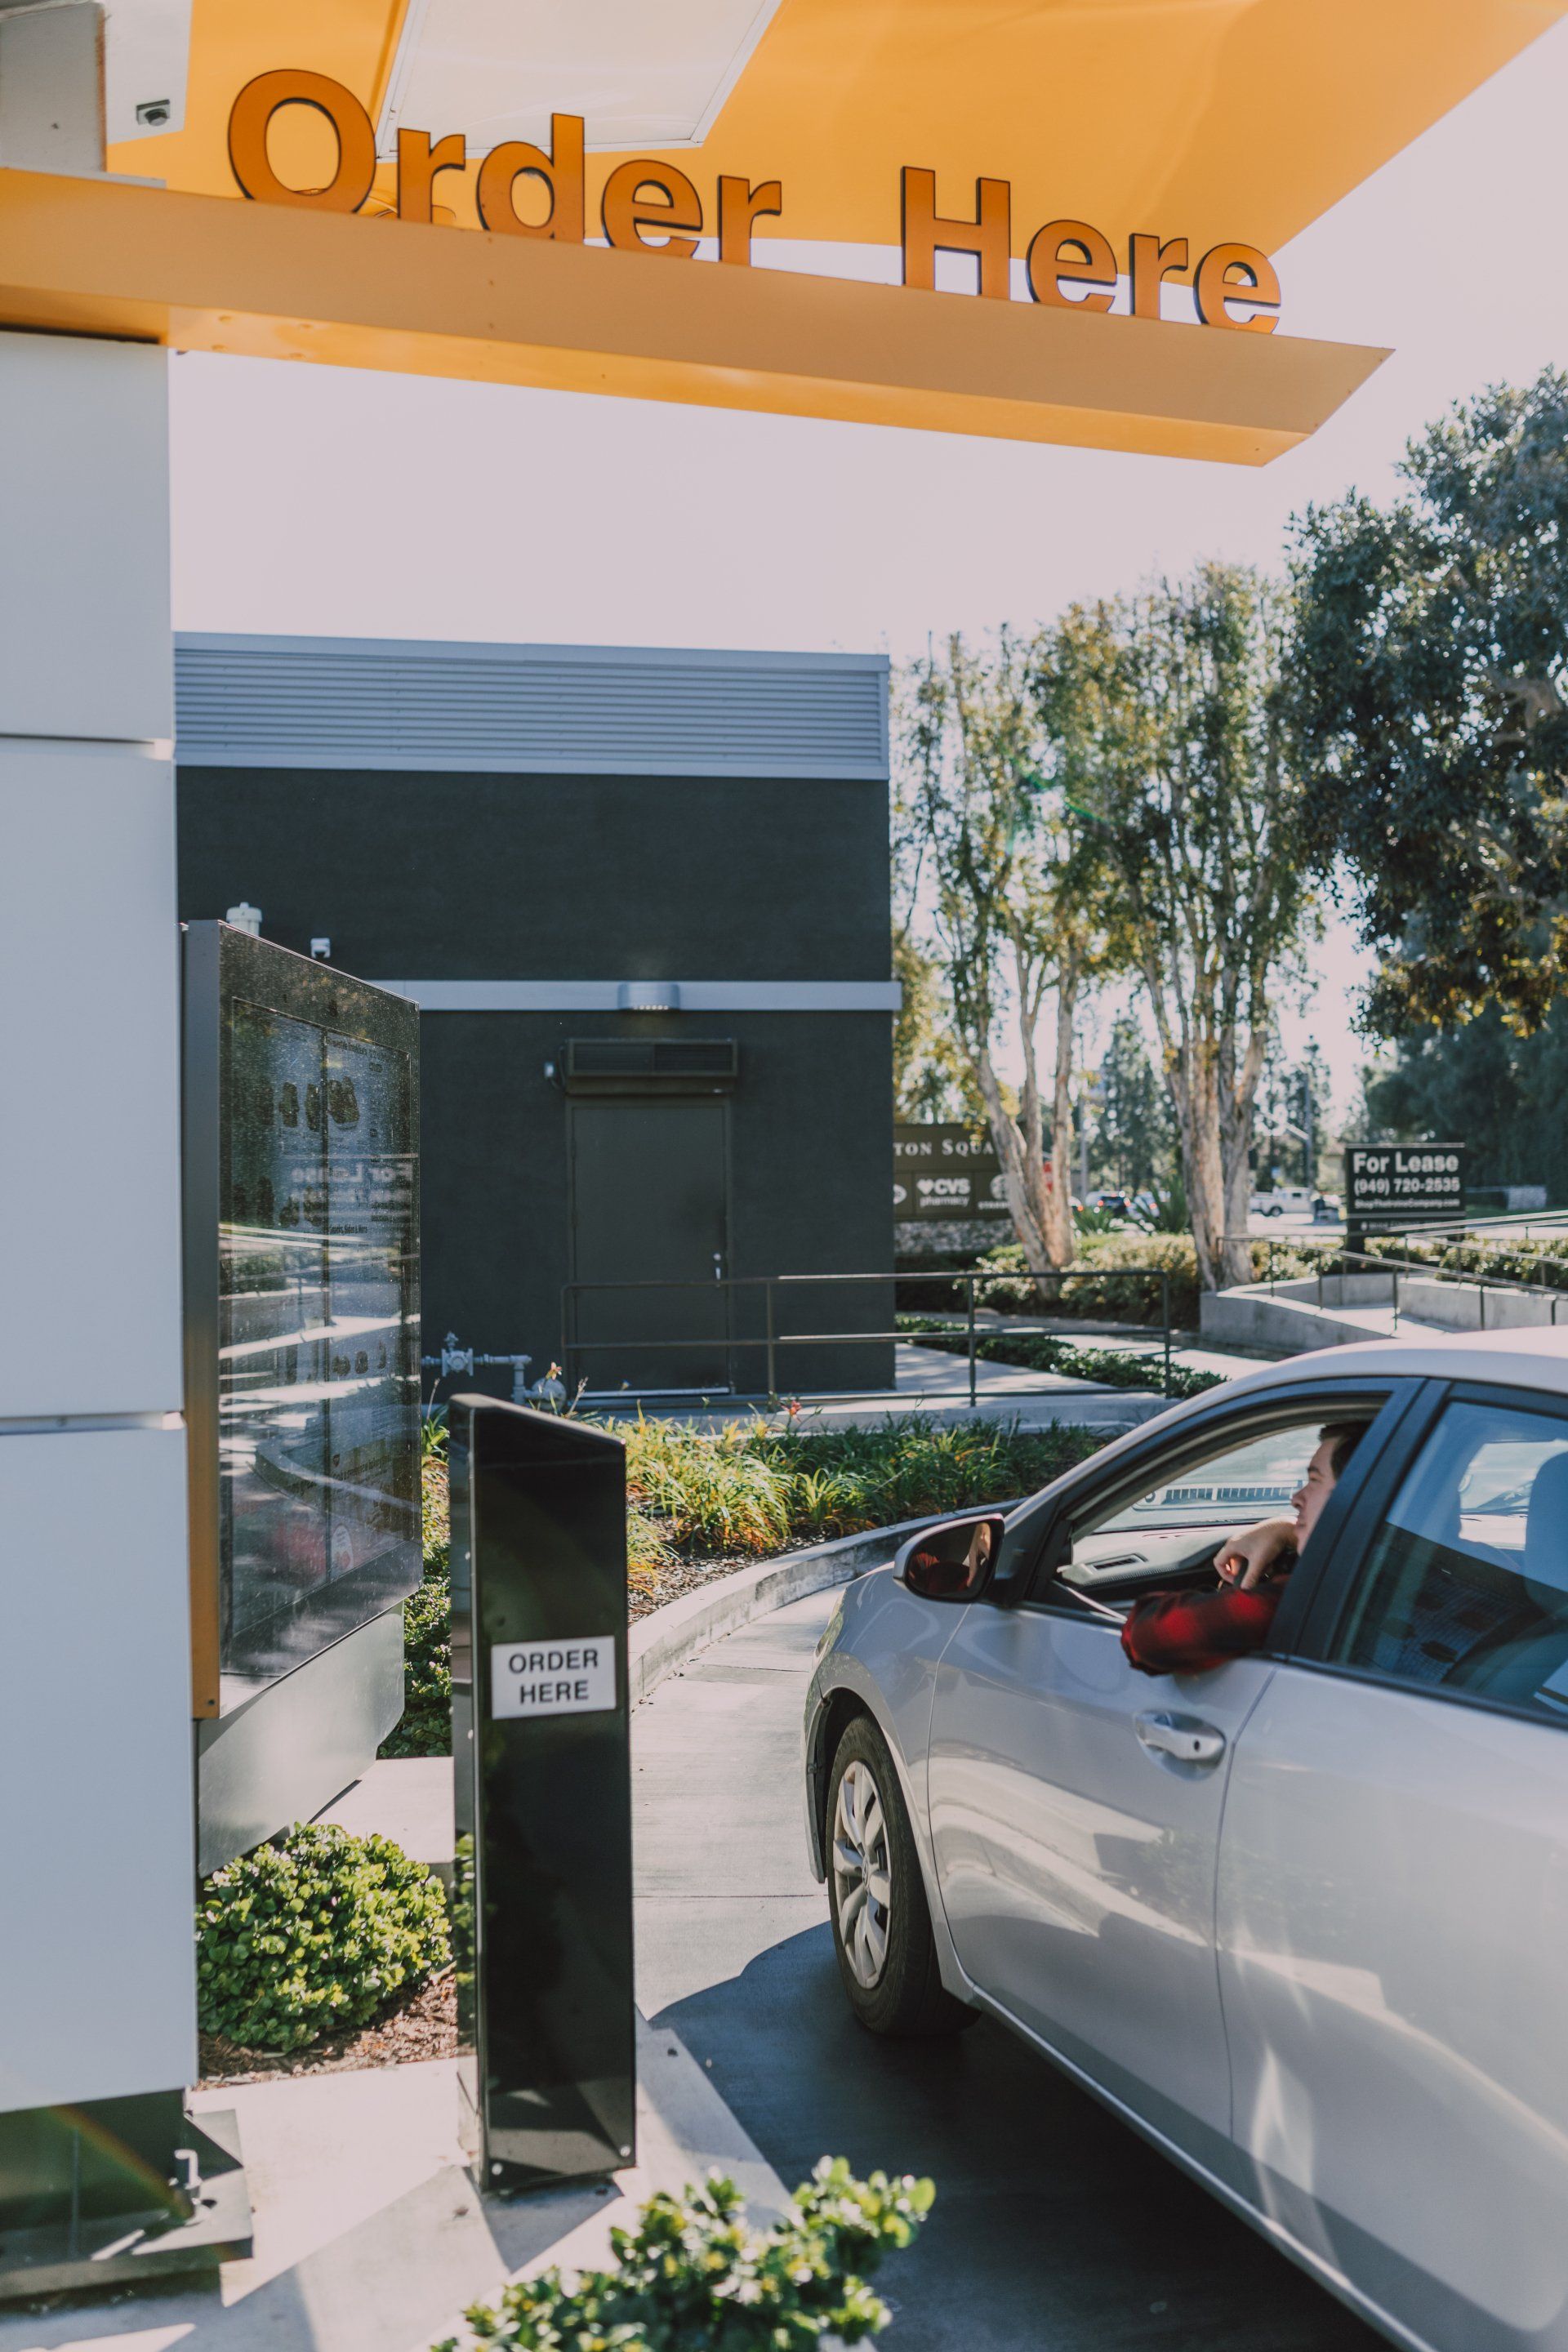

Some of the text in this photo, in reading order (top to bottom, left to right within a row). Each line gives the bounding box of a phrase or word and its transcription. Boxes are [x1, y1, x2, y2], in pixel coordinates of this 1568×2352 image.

[227, 69, 1281, 334] Order Here
[893, 1138, 995, 1157] TON SQUA
[1353, 1151, 1459, 1174] For Lease
[933, 1178, 971, 1195] CVS
[1354, 1178, 1390, 1196] (949)
[919, 1195, 970, 1207] pharmacy
[508, 1648, 599, 1673] ORDER
[519, 1679, 589, 1705] HERE
